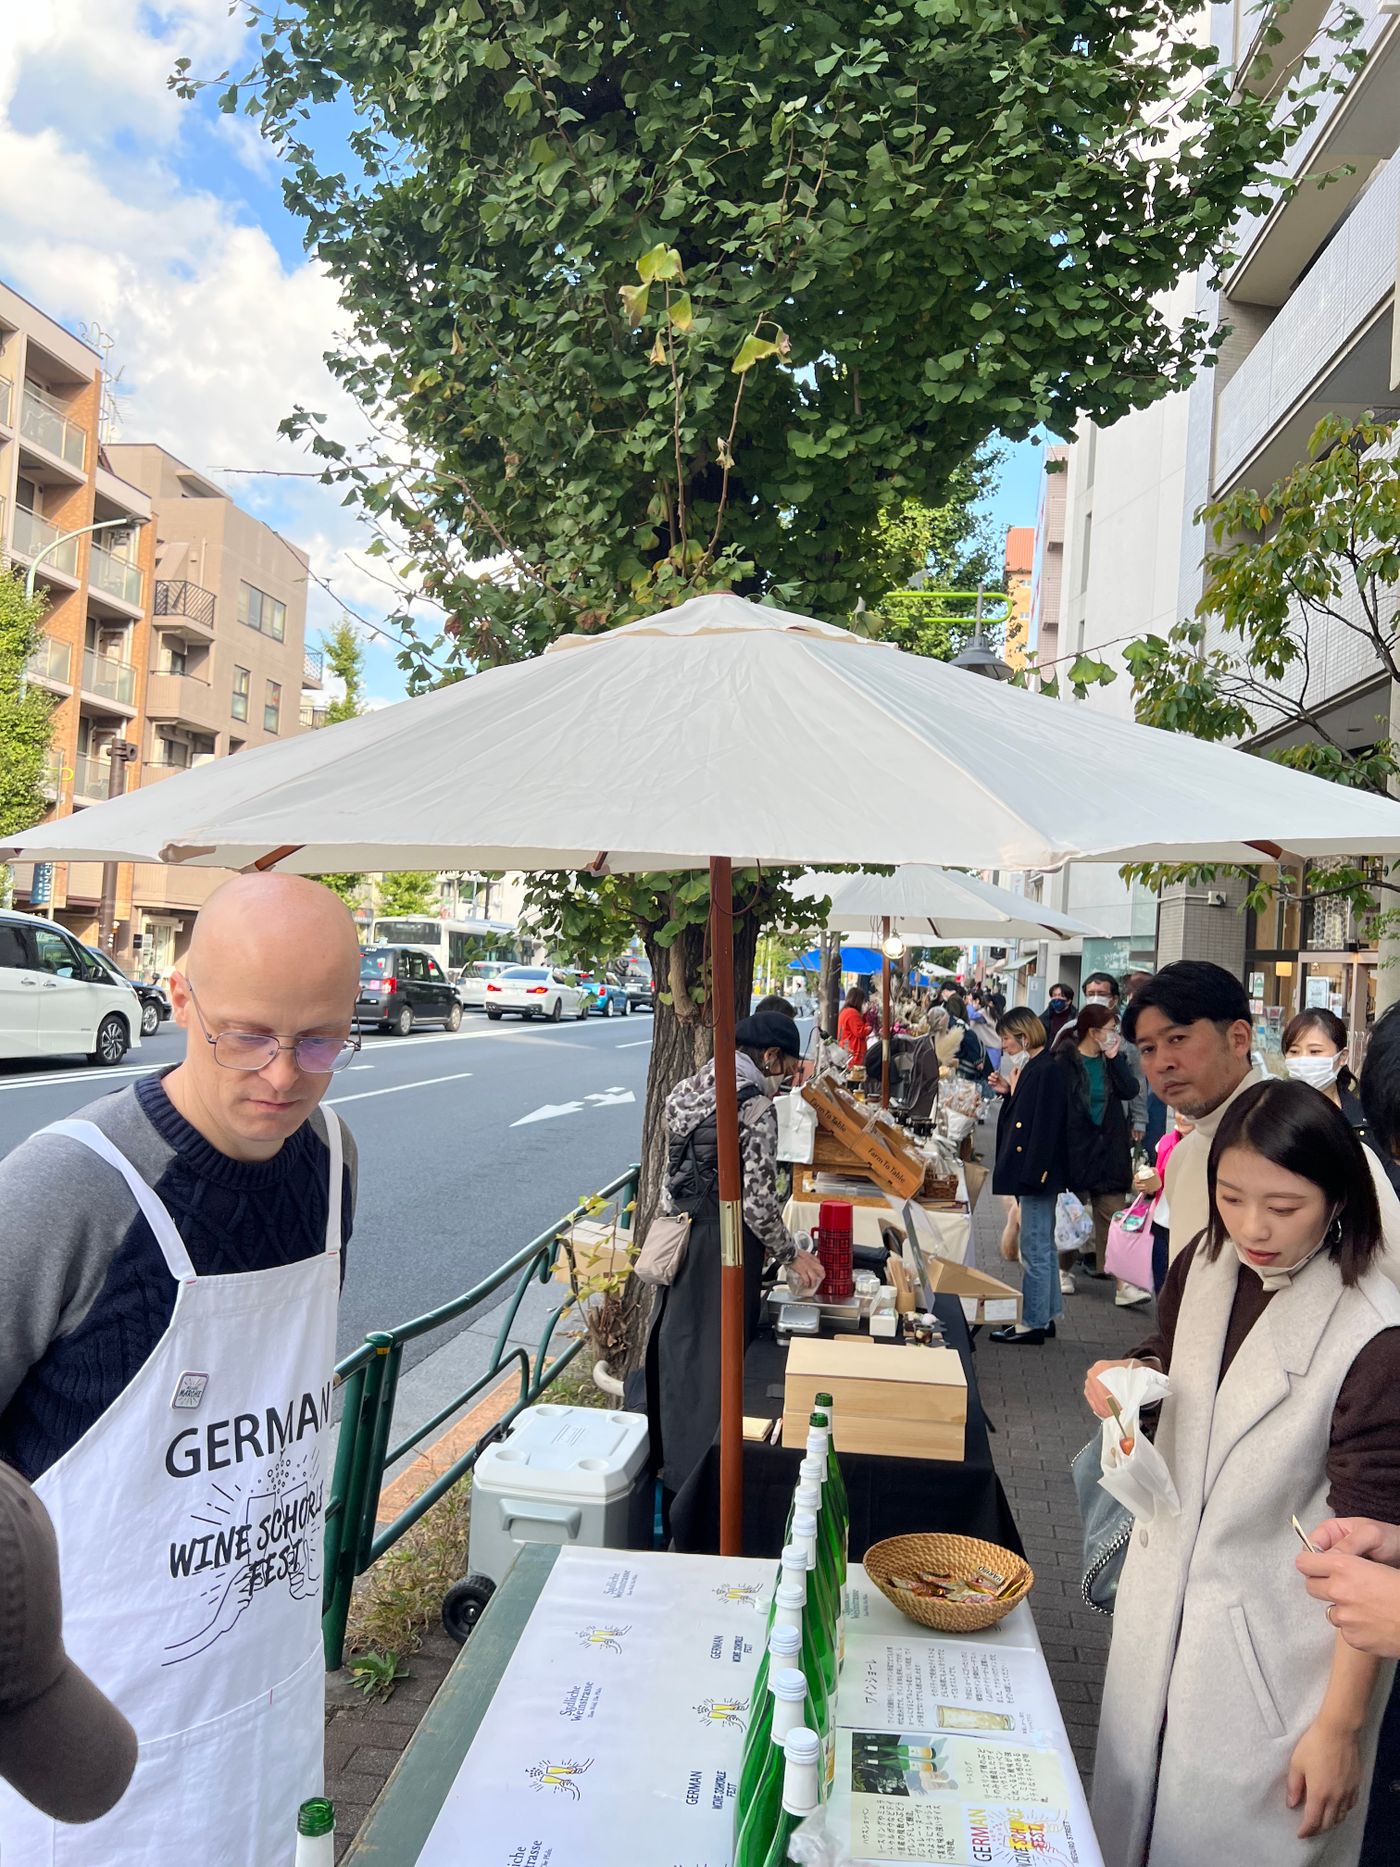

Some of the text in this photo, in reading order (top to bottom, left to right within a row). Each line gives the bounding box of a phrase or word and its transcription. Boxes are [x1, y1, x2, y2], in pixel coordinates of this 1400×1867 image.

[810, 1098, 825, 1113] Farm
[831, 1118, 847, 1133] Table
[868, 1147, 883, 1165] Farm
[890, 1168, 906, 1184] Table
[165, 1381, 330, 1478] GERMAN
[169, 1524, 252, 1579] WINE
[248, 1538, 302, 1597] FEST
[978, 1566, 1002, 1582] HARIBO
[710, 1635, 724, 1659] GERMAN
[864, 1658, 877, 1704] ワインショーレ
[571, 1682, 593, 1721] Weinstrasse
[686, 1771, 702, 1805] GERMAN
[712, 1771, 726, 1809] WINE SCHORLE
[727, 1783, 736, 1797] FEST
[968, 1809, 992, 1862] GERMAN
[1063, 1820, 1073, 1840] STREET
